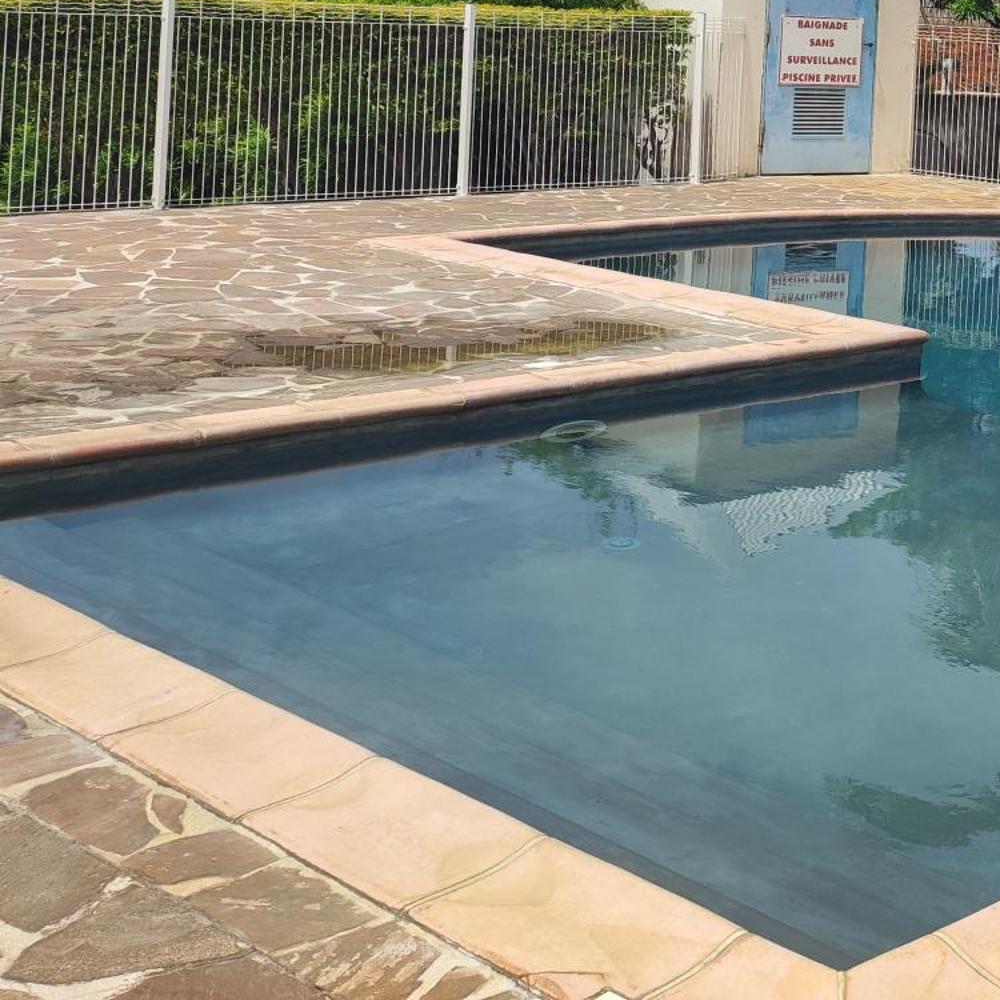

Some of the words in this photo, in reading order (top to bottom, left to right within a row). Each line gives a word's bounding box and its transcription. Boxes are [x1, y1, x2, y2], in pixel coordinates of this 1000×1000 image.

[798, 20, 848, 30] BAIGNADE
[809, 38, 834, 47] SANS
[787, 55, 857, 65] SURVEILLANCE
[782, 73, 820, 82] PISCINE
[824, 74, 857, 83] PRIVEE
